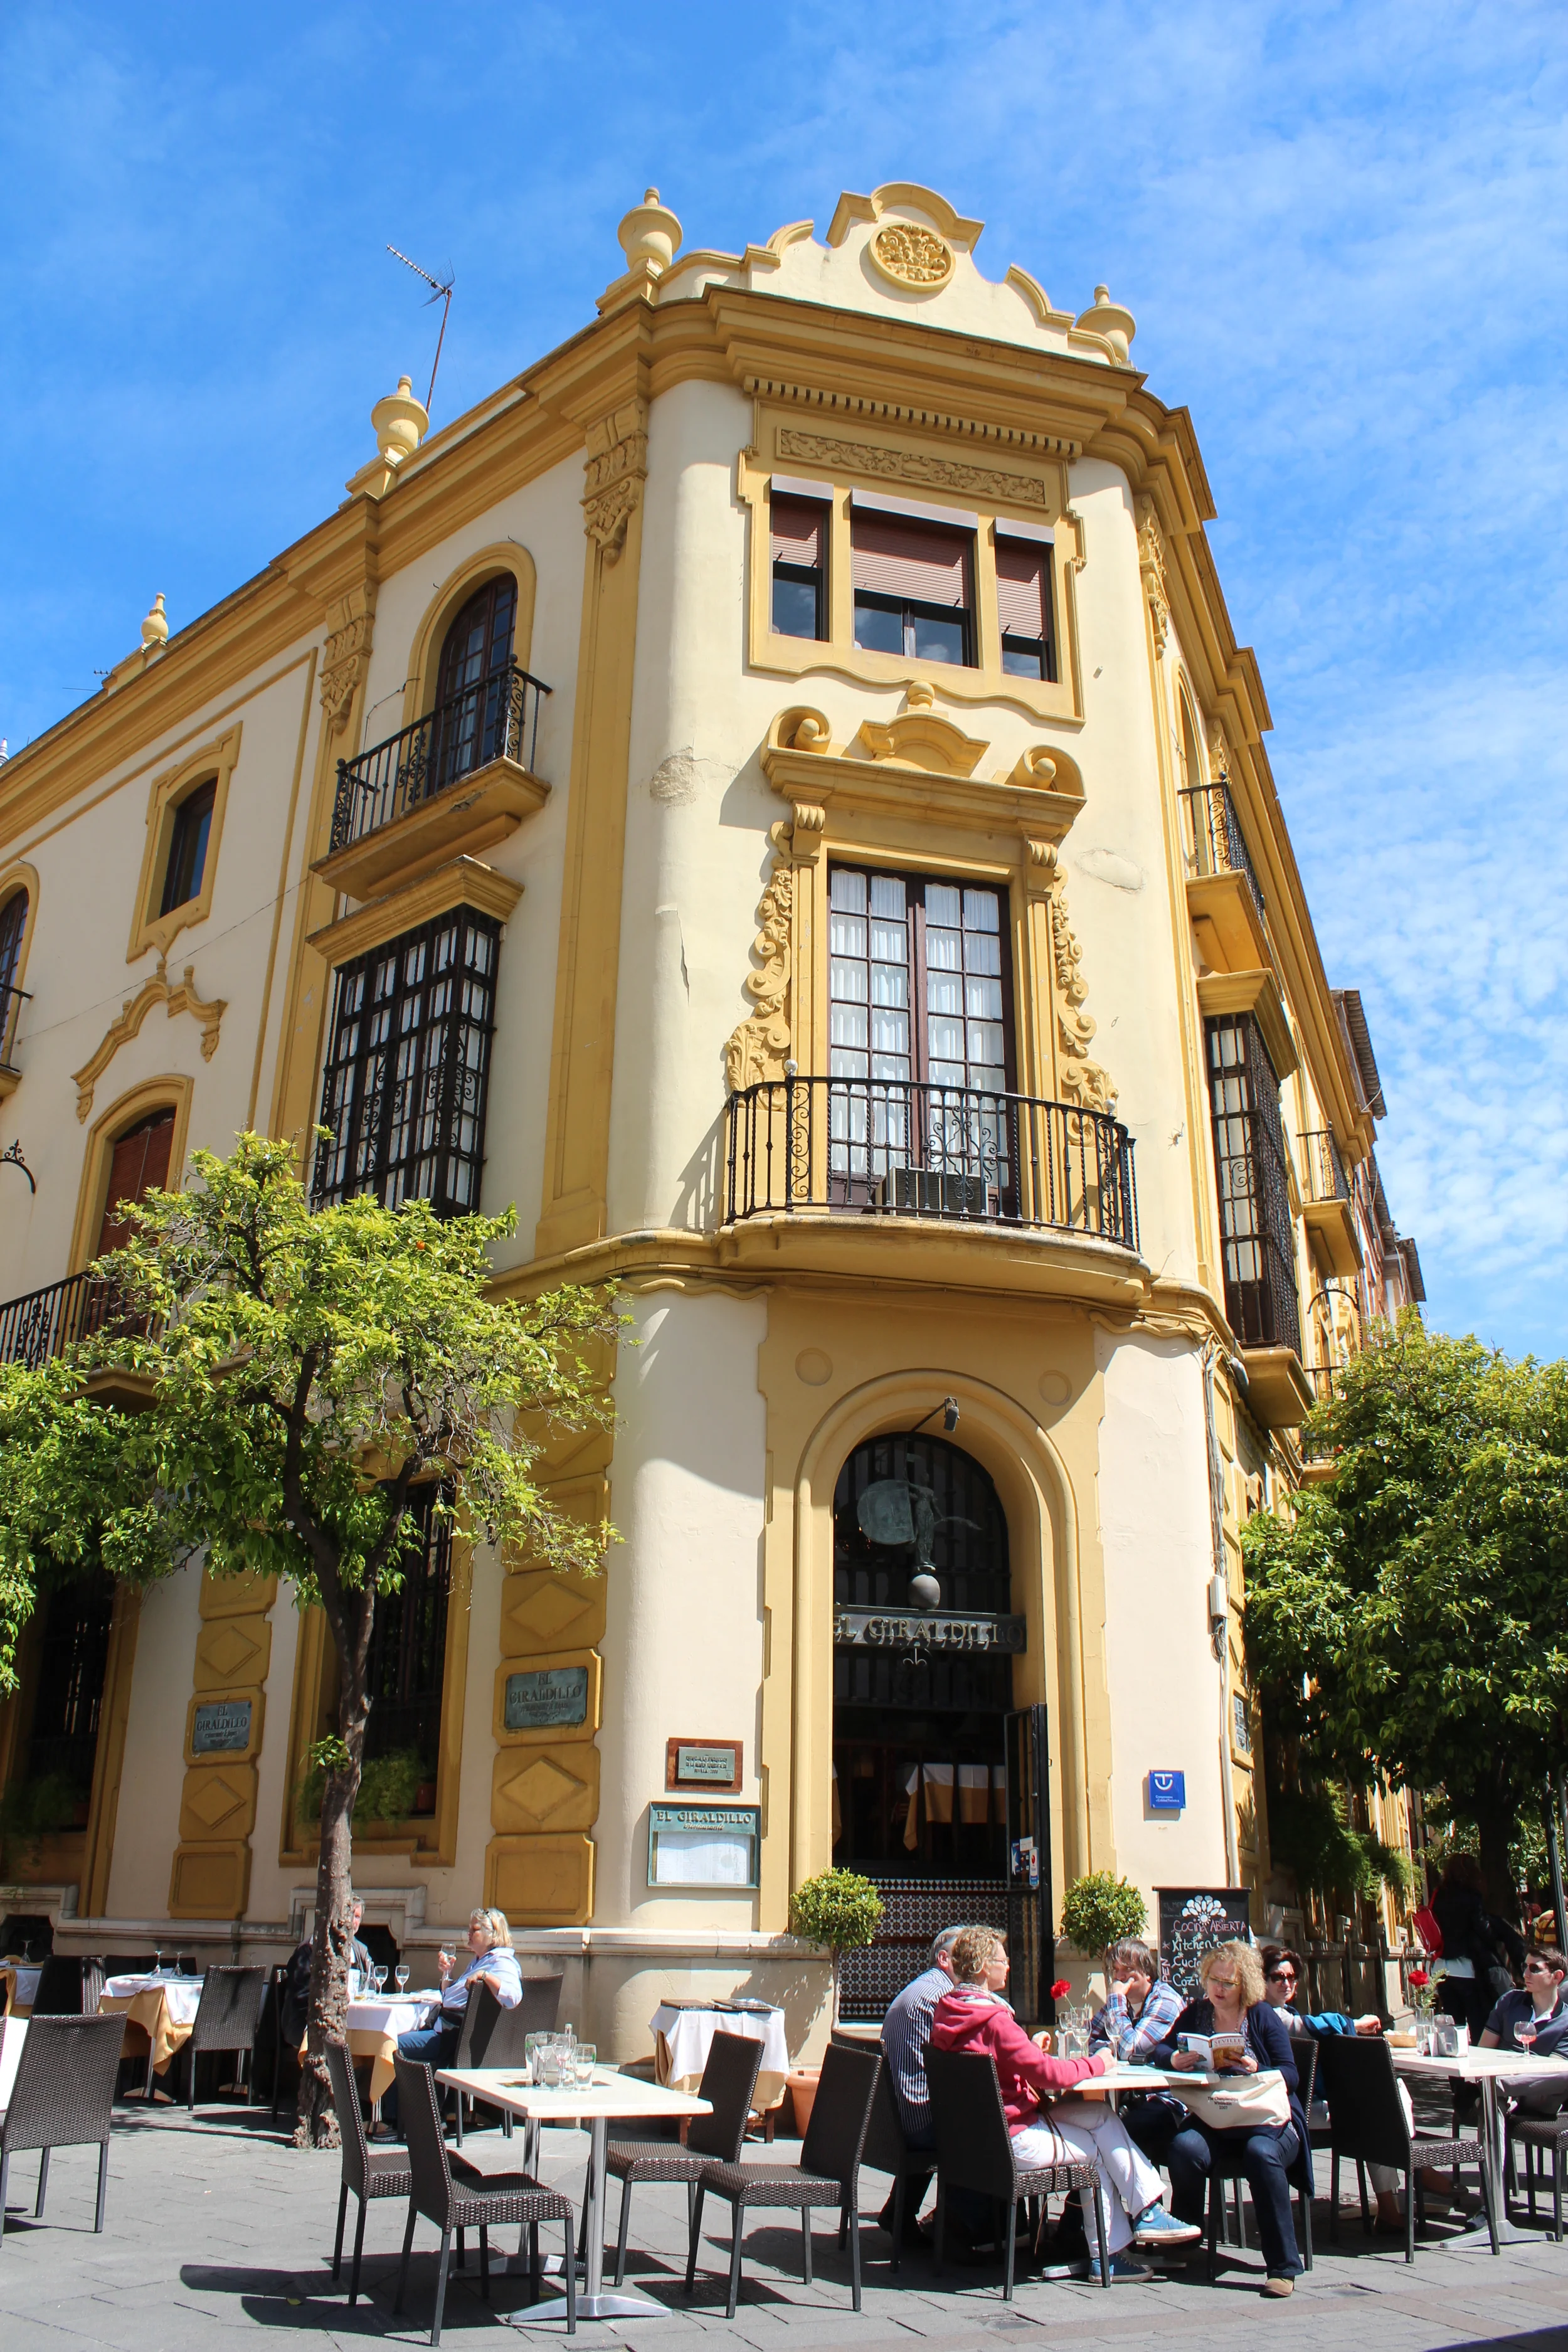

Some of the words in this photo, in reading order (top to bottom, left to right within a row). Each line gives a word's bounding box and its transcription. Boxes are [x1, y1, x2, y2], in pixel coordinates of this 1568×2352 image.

[868, 1617, 1024, 1645] GIRALDILLO
[538, 1672, 552, 1685] EL
[510, 1685, 581, 1704] GIRALDILLO
[218, 1705, 228, 1717] EL
[197, 1717, 247, 1731] GIRALDILLO
[656, 1810, 672, 1822] EL
[677, 1811, 752, 1824] GIRALDILLO
[683, 1821, 724, 1831] Restaurante
[1172, 1936, 1214, 1952] Kitchen
